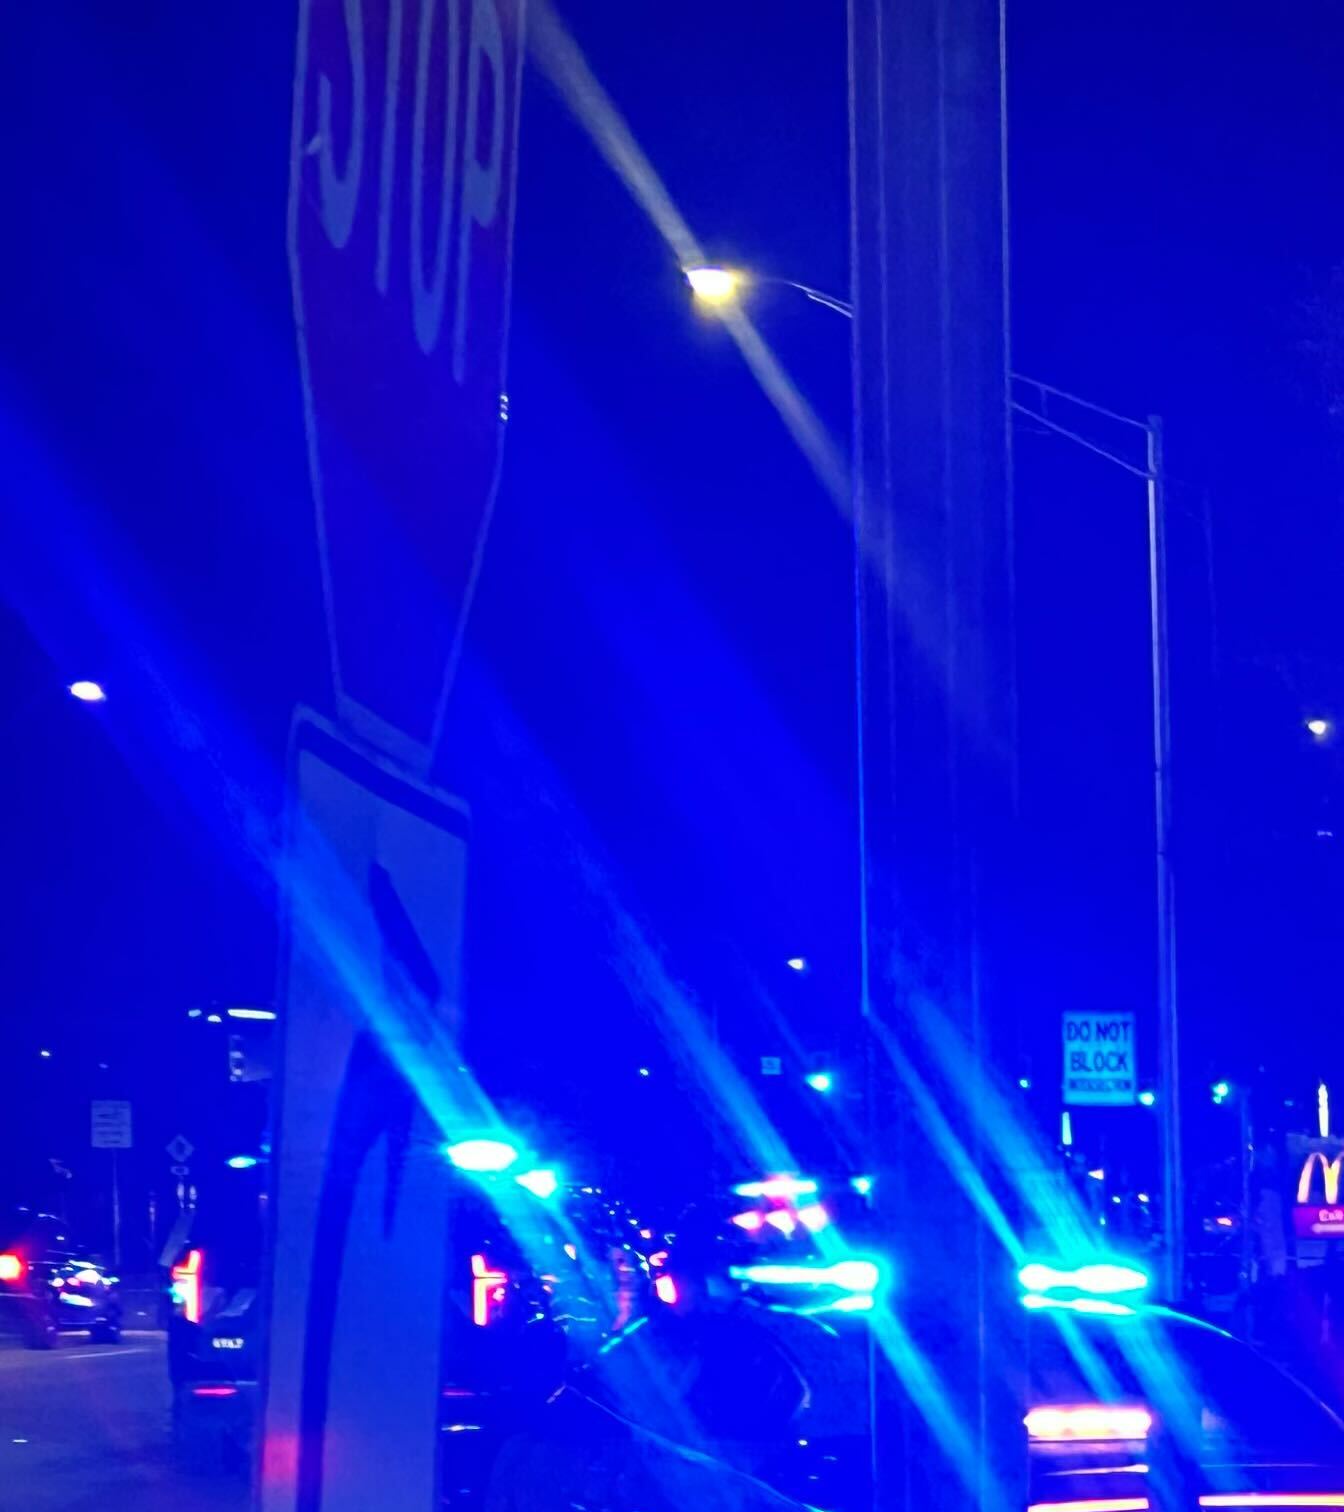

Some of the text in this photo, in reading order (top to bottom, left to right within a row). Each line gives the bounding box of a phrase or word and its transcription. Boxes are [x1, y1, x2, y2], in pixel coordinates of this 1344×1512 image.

[1066, 1020, 1131, 1042] DO NOT
[1070, 1050, 1128, 1072] BLOCK
